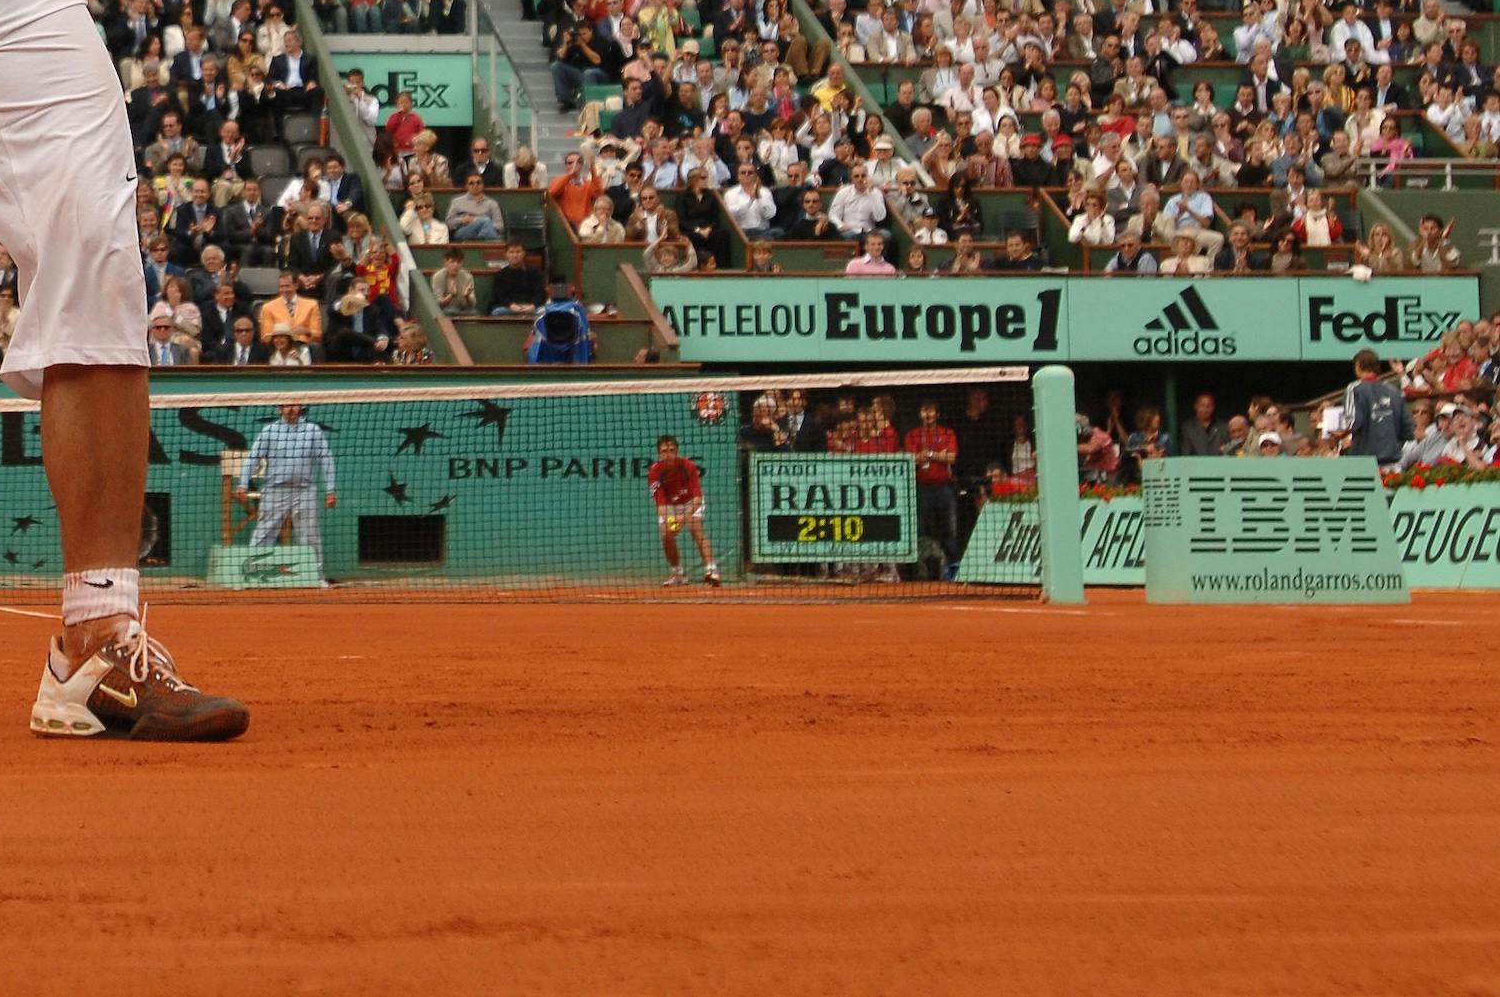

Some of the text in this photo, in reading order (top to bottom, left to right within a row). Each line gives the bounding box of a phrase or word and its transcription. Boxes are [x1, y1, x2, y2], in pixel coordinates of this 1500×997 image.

[662, 304, 817, 337] AFFLELOU
[1308, 295, 1461, 343] FedEx
[1133, 330, 1238, 356] adidas
[449, 456, 528, 480] BNP
[771, 483, 899, 512] RADO
[797, 515, 865, 543] 2:10
[1188, 477, 1378, 553] IBM
[1393, 507, 1500, 564] PEUGE
[1191, 567, 1402, 598] www.rolandgarros.com
